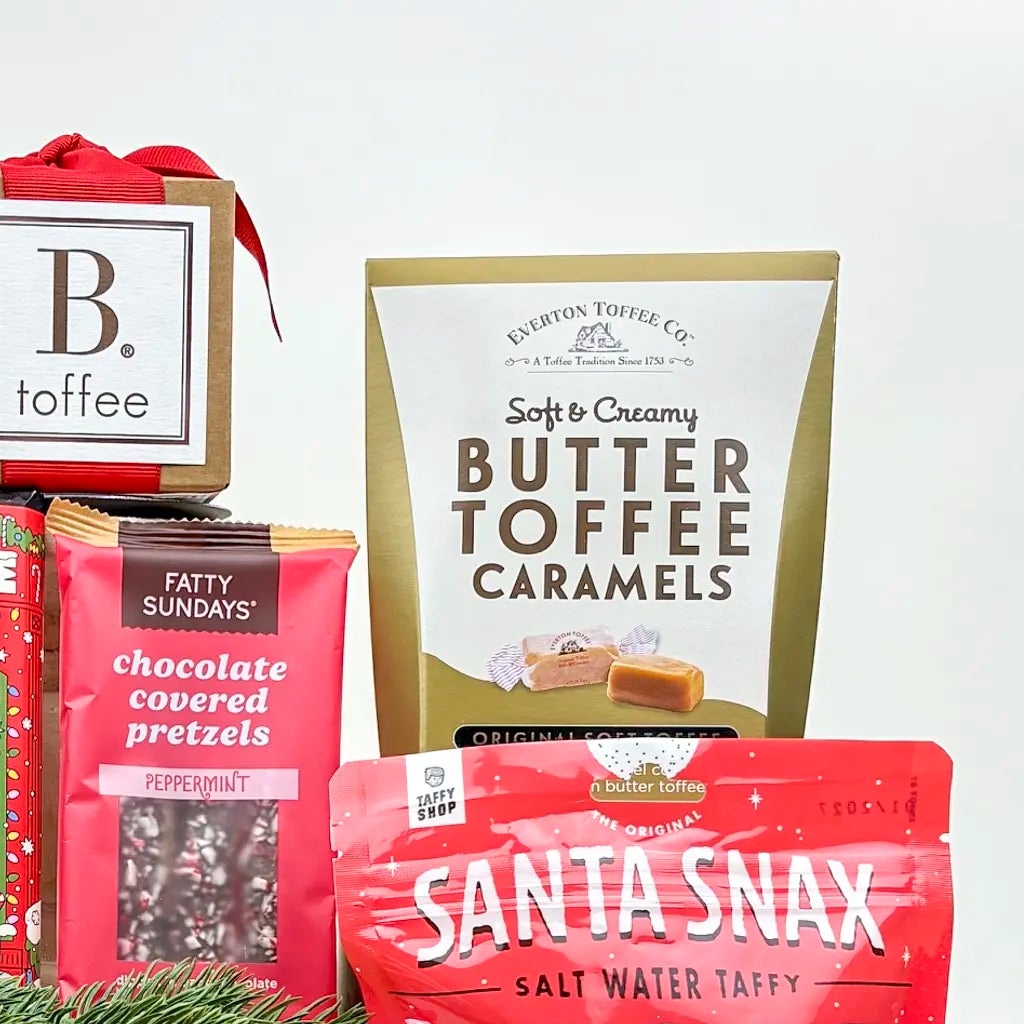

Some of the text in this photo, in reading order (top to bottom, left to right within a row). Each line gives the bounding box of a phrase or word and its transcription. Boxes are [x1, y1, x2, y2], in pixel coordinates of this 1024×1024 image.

[506, 304, 588, 346] EVERTON
[593, 301, 661, 327] TOFFEE
[533, 356, 665, 366] A Toffee Tradition Since 1753
[17, 373, 149, 418] toffee
[505, 396, 699, 433] Soft & Creamy
[456, 437, 751, 494] BUTTER
[451, 498, 751, 557] TOFFEE
[164, 572, 233, 595] FATTY
[472, 563, 733, 601] CARAMELS
[112, 649, 288, 682] chocolate
[128, 687, 269, 714] covered
[125, 719, 271, 748] pretzels
[145, 771, 251, 800] PEPPERMINT
[416, 787, 455, 807] TAFFY
[605, 780, 655, 793] butter
[659, 780, 706, 793] toffee
[417, 801, 456, 821] SHOP
[591, 809, 703, 837] THE ORIGINAL
[413, 845, 886, 969] SANTA SNAX
[514, 967, 800, 1000] SALT WATER TAFFY
